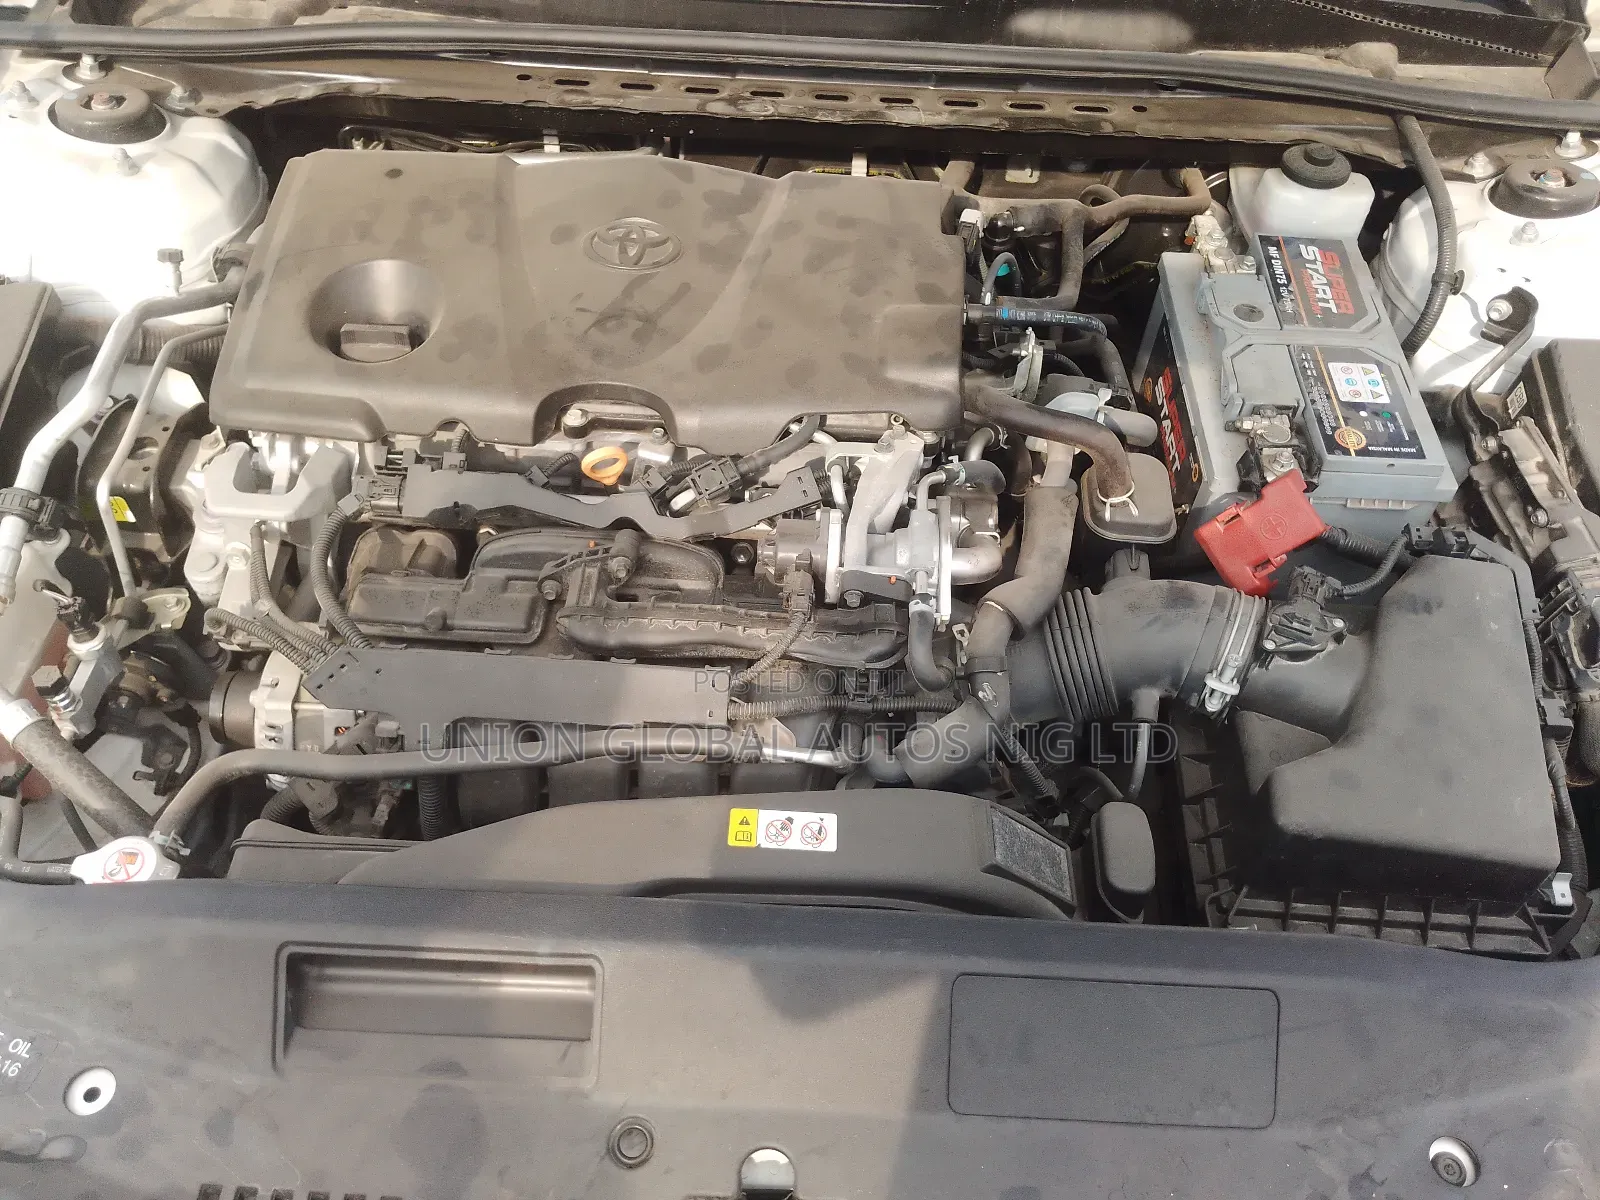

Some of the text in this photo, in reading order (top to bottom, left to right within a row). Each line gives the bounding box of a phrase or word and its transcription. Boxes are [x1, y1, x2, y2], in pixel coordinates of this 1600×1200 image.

[1267, 246, 1280, 259] MF
[1271, 259, 1288, 285] DIN75
[1299, 243, 1338, 314] START
[1318, 249, 1354, 314] SUPER
[1154, 376, 1181, 473] START
[1162, 366, 1187, 465] SUPER
[0, 1055, 22, 1077] 16
[8, 1038, 31, 1058] OIL
